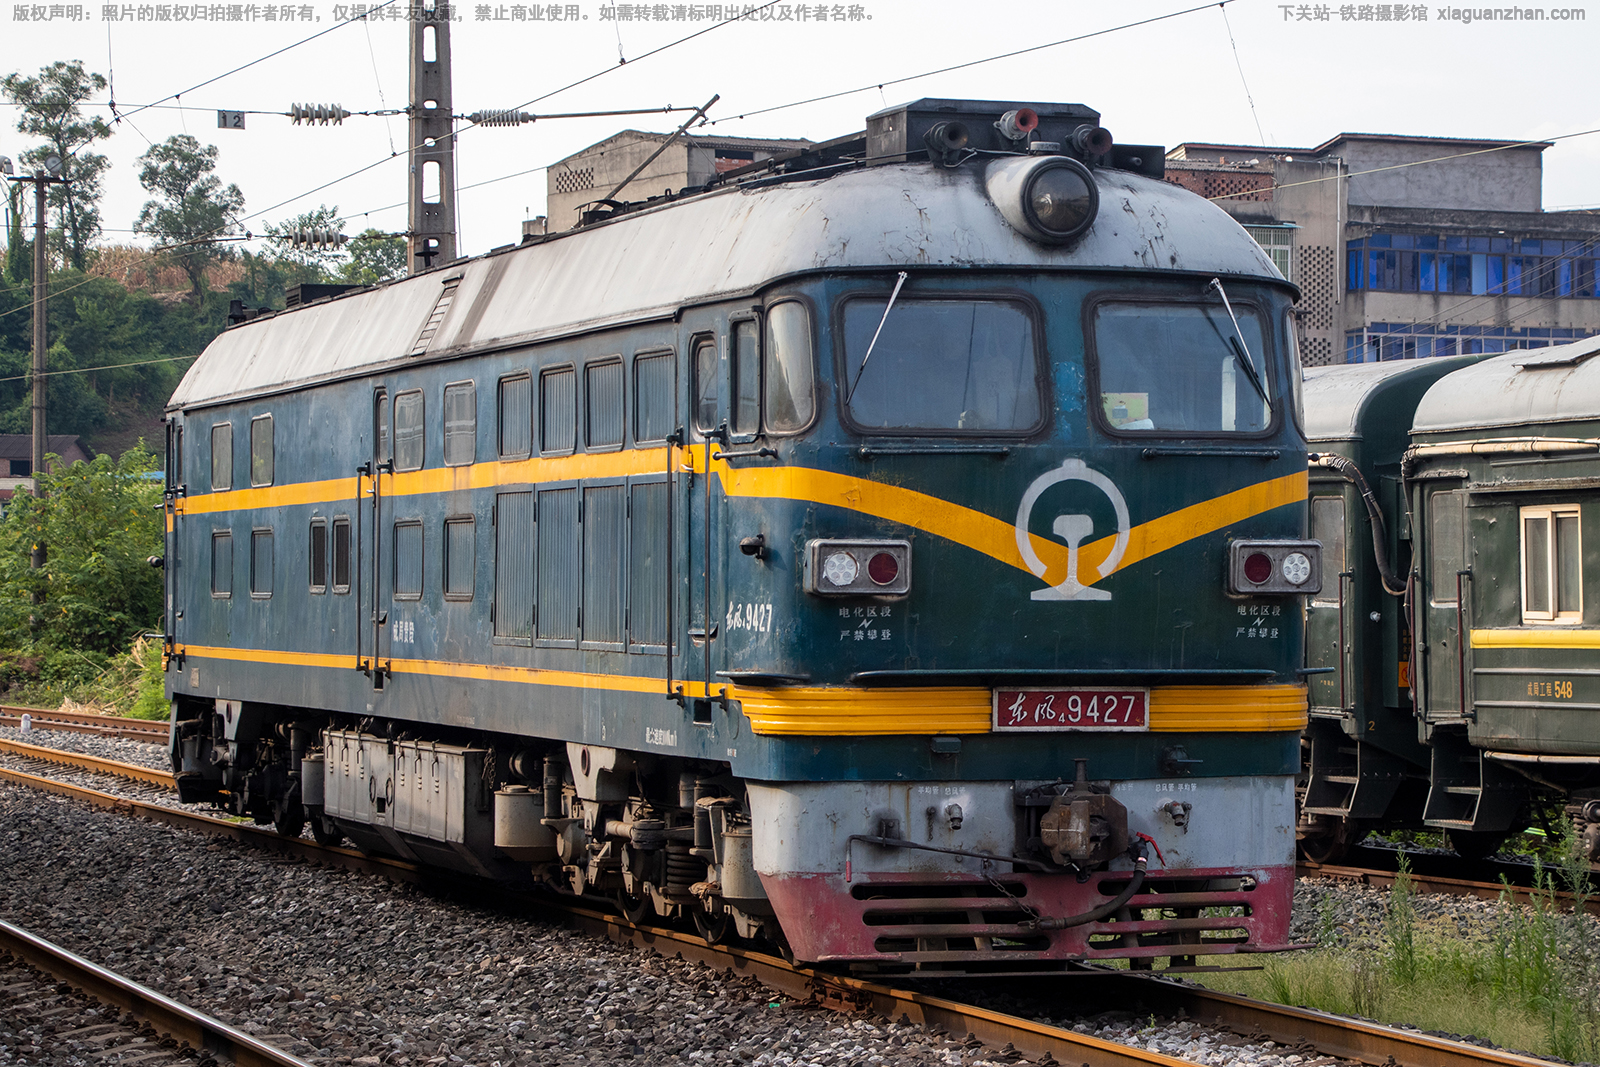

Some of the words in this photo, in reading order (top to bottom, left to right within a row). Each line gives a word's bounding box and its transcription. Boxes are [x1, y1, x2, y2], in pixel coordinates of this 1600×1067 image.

[221, 113, 242, 128] 12
[838, 605, 892, 618] 电化区段
[1236, 604, 1281, 616] 电化区段
[839, 628, 892, 641] 严禁攀登
[1554, 680, 1573, 699] 548
[1367, 720, 1376, 731] 2
